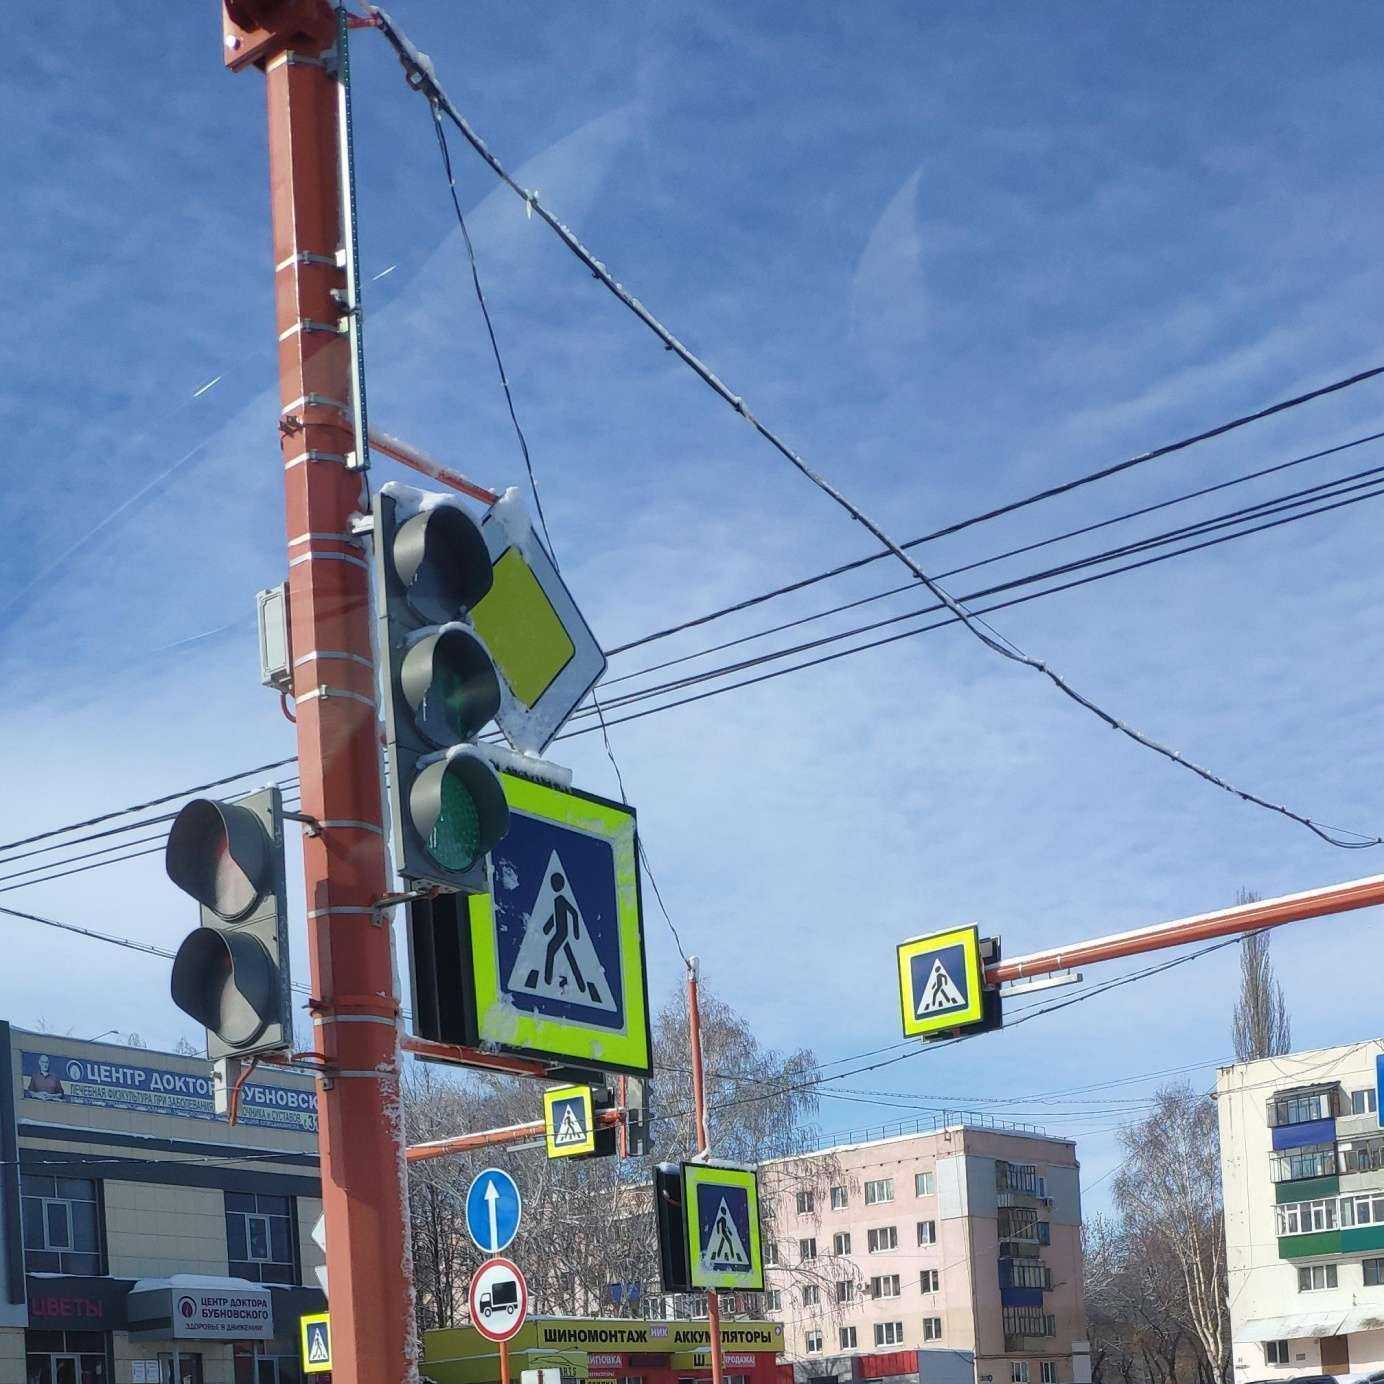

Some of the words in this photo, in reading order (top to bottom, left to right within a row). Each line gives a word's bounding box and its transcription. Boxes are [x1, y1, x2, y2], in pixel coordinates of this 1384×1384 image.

[86, 1063, 146, 1086] ЦЕНТР
[149, 1072, 215, 1097] ДОКТОР
[167, 1096, 215, 1113] ЗАБОЛЕВАНИЯ
[31, 1296, 103, 1319] ЦВЕТЫ
[201, 1297, 228, 1307] ЦЕНТР
[230, 1298, 267, 1309] ДОКТОРА
[201, 1308, 269, 1320] БУБНОВСКОГО
[543, 1328, 648, 1343] ШИНОМОНТАЖ
